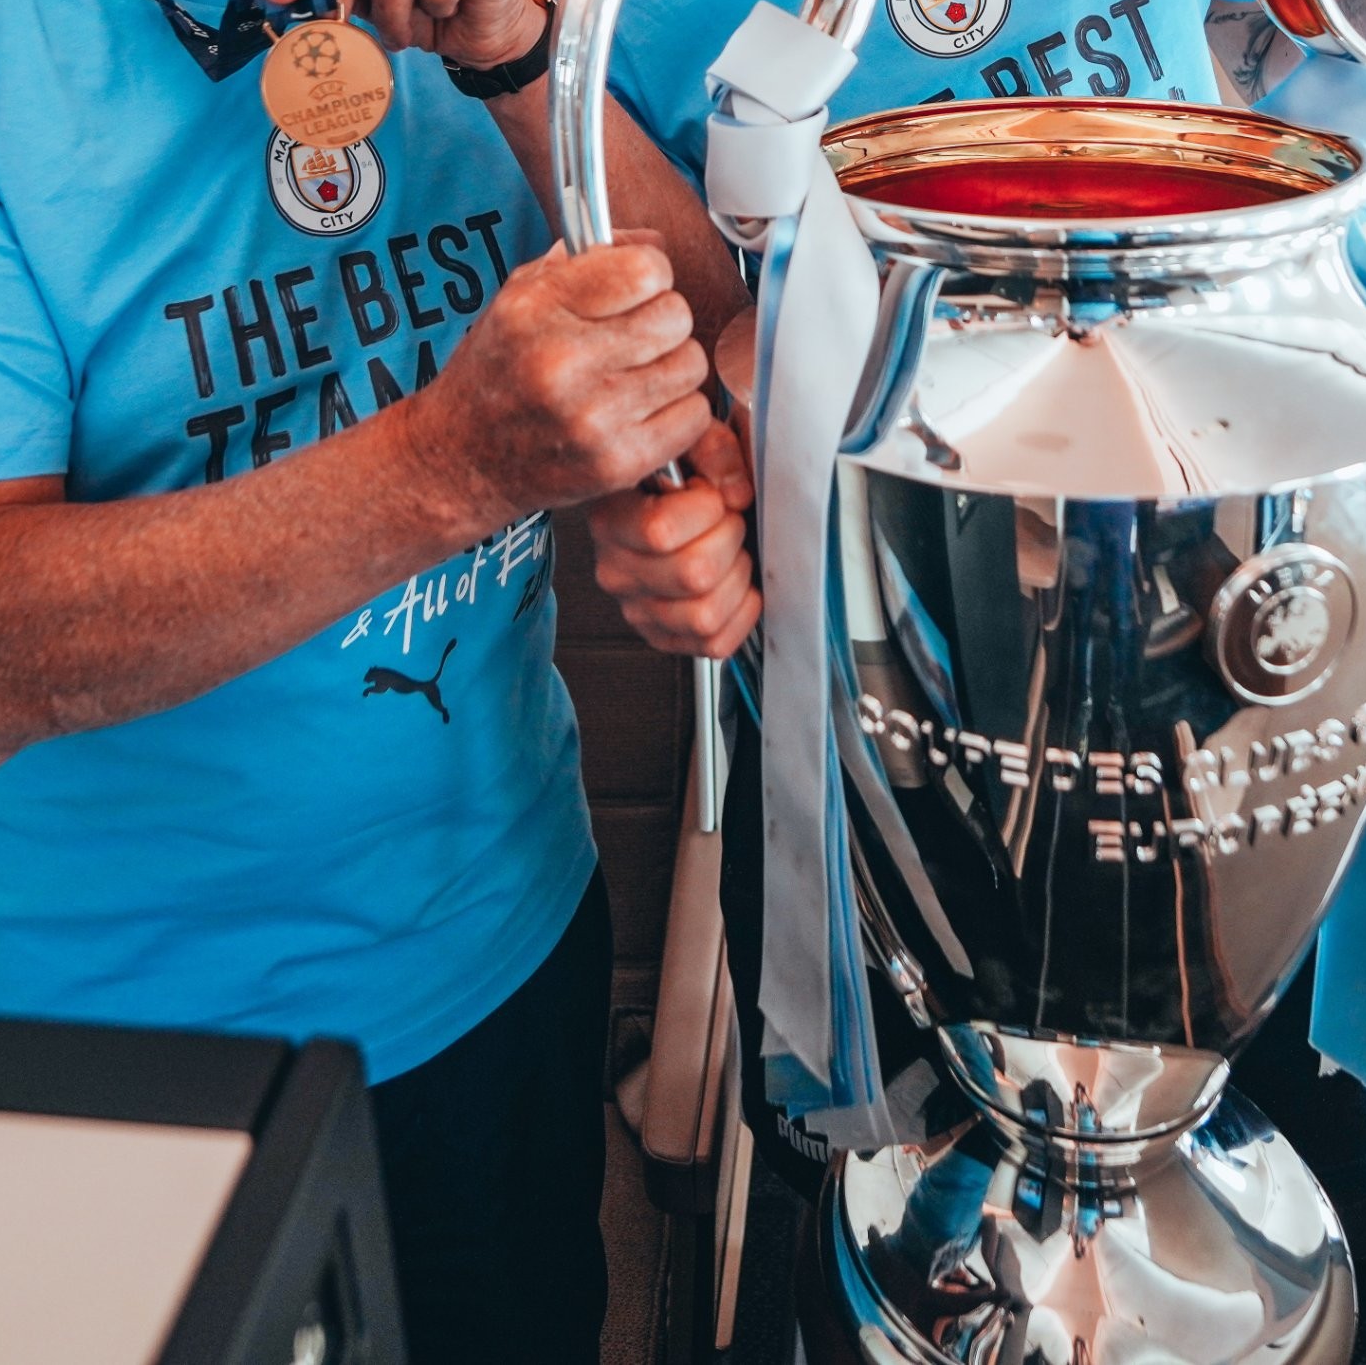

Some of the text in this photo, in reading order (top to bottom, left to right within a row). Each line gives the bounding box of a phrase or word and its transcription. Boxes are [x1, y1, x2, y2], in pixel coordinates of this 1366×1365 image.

[953, 25, 986, 49] CITY
[280, 86, 387, 128] CHAMPIONS
[302, 107, 374, 136] LEAGUE
[320, 211, 354, 229] CITY
[164, 210, 511, 399] THE BEST
[340, 608, 373, 649] &
[383, 573, 448, 655] All
[455, 544, 487, 605] of
[1045, 746, 1163, 797] DES
